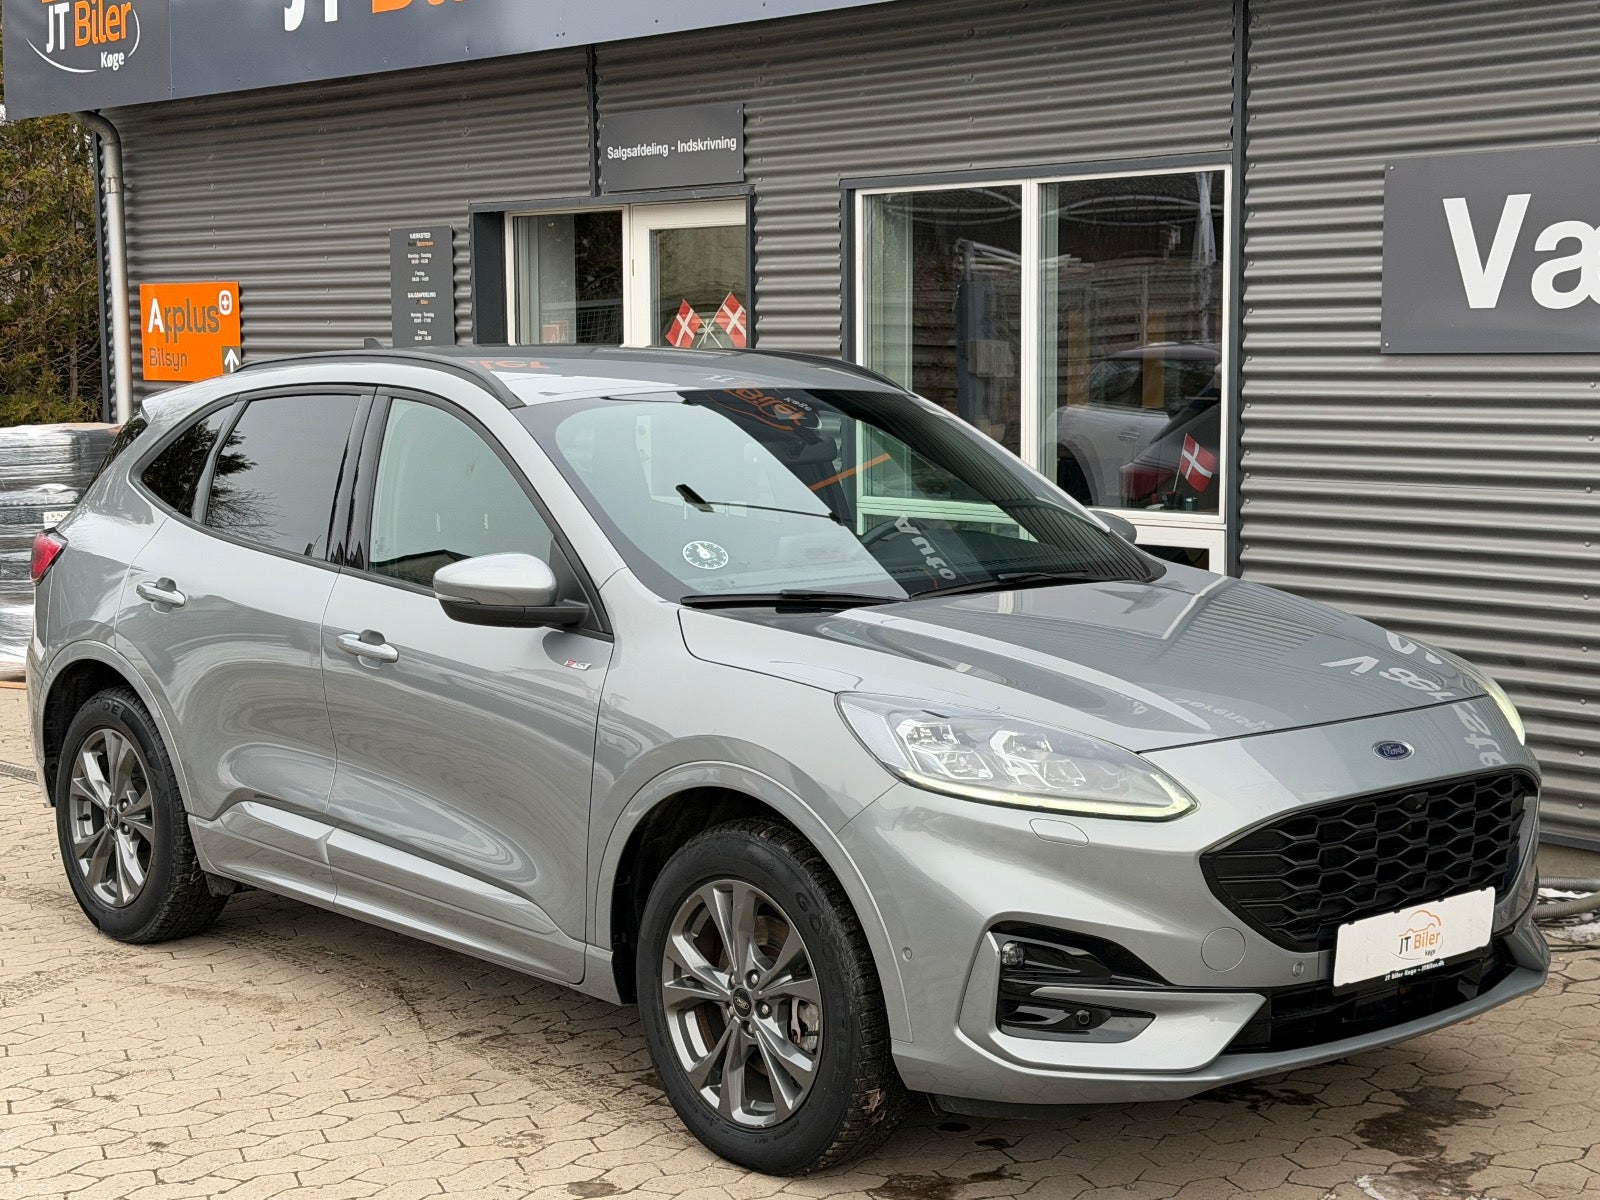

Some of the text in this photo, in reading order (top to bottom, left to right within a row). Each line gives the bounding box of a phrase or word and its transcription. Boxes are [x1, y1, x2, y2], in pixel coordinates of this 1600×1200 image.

[46, 0, 131, 54] JT Biler
[100, 51, 125, 71] Køge
[607, 143, 669, 161] Salgsafdeling
[677, 136, 737, 153] Indskrivning
[149, 347, 188, 372] Bilsyn
[1398, 932, 1440, 955] JT Biler
